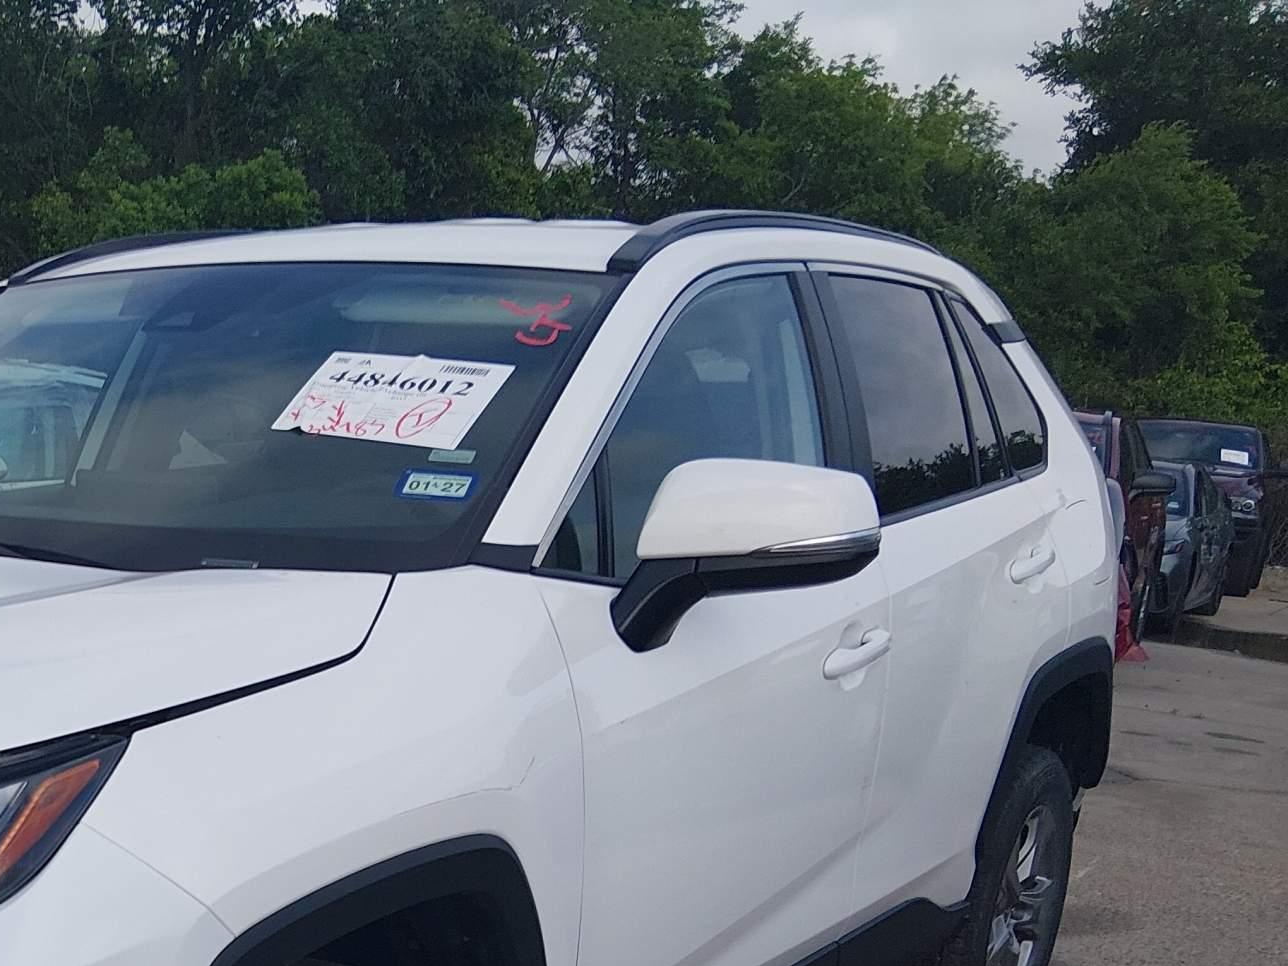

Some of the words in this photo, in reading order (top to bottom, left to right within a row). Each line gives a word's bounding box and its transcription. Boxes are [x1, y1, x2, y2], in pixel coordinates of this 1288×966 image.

[329, 369, 475, 397] 44846012
[408, 480, 431, 491] 01
[441, 482, 466, 493] 27
